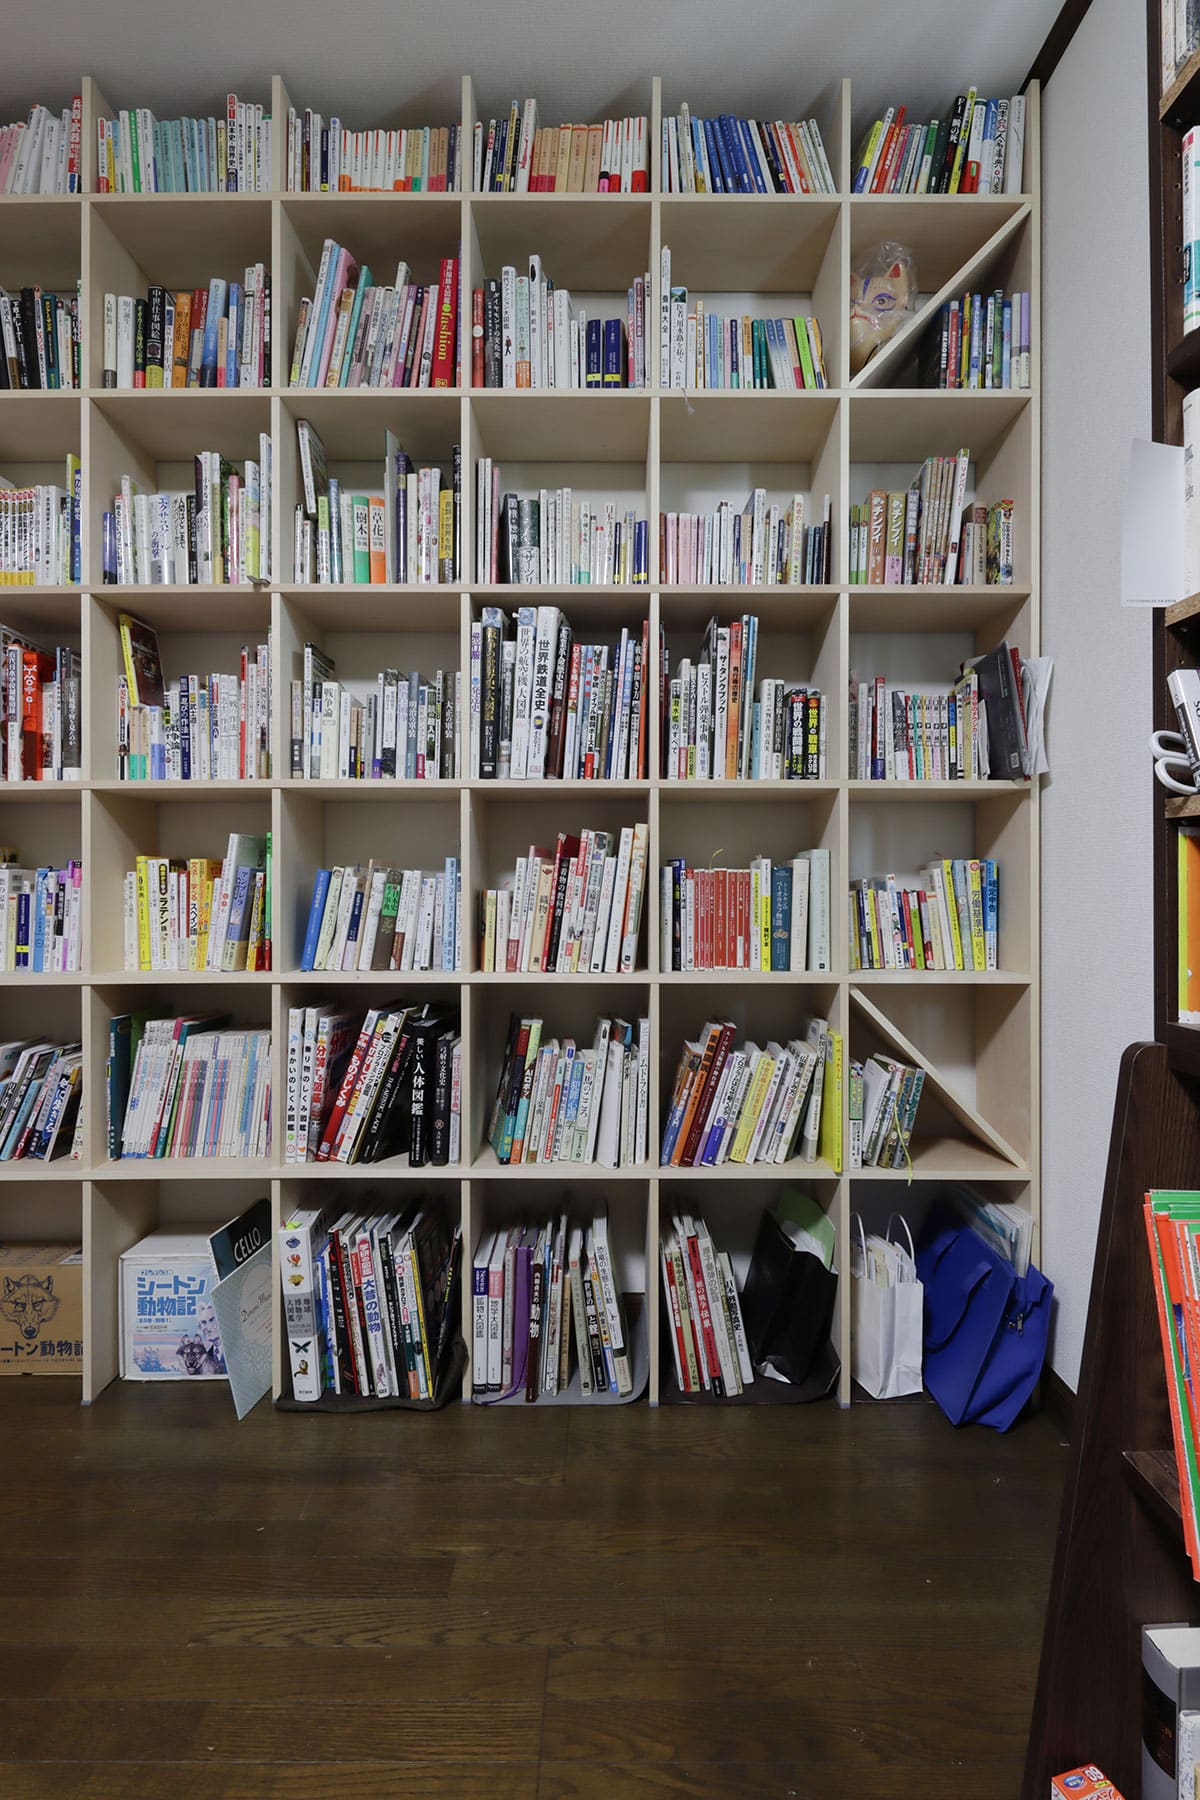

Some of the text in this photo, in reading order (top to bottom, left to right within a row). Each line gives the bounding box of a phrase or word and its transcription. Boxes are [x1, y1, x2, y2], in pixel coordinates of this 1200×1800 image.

[438, 313, 452, 361] fashion
[356, 510, 369, 535] 樹木
[372, 511, 385, 537] 草花
[872, 506, 883, 545] チンプイ
[892, 509, 903, 546] チンプイ
[516, 628, 529, 719] 世界の航空機大図鑑
[534, 639, 551, 711] 世界鉄道全史
[717, 655, 729, 714] ザ・タンクブック
[323, 687, 333, 718] 戦争論
[287, 1048, 298, 1132] きかいのしくみ図鑑
[411, 1037, 426, 1116] 美しい人体図鑑
[233, 1228, 261, 1263] CELLO
[137, 1275, 206, 1296] シートン
[137, 1296, 198, 1316] 動物記
[363, 1279, 381, 1334] 大昔の動物
